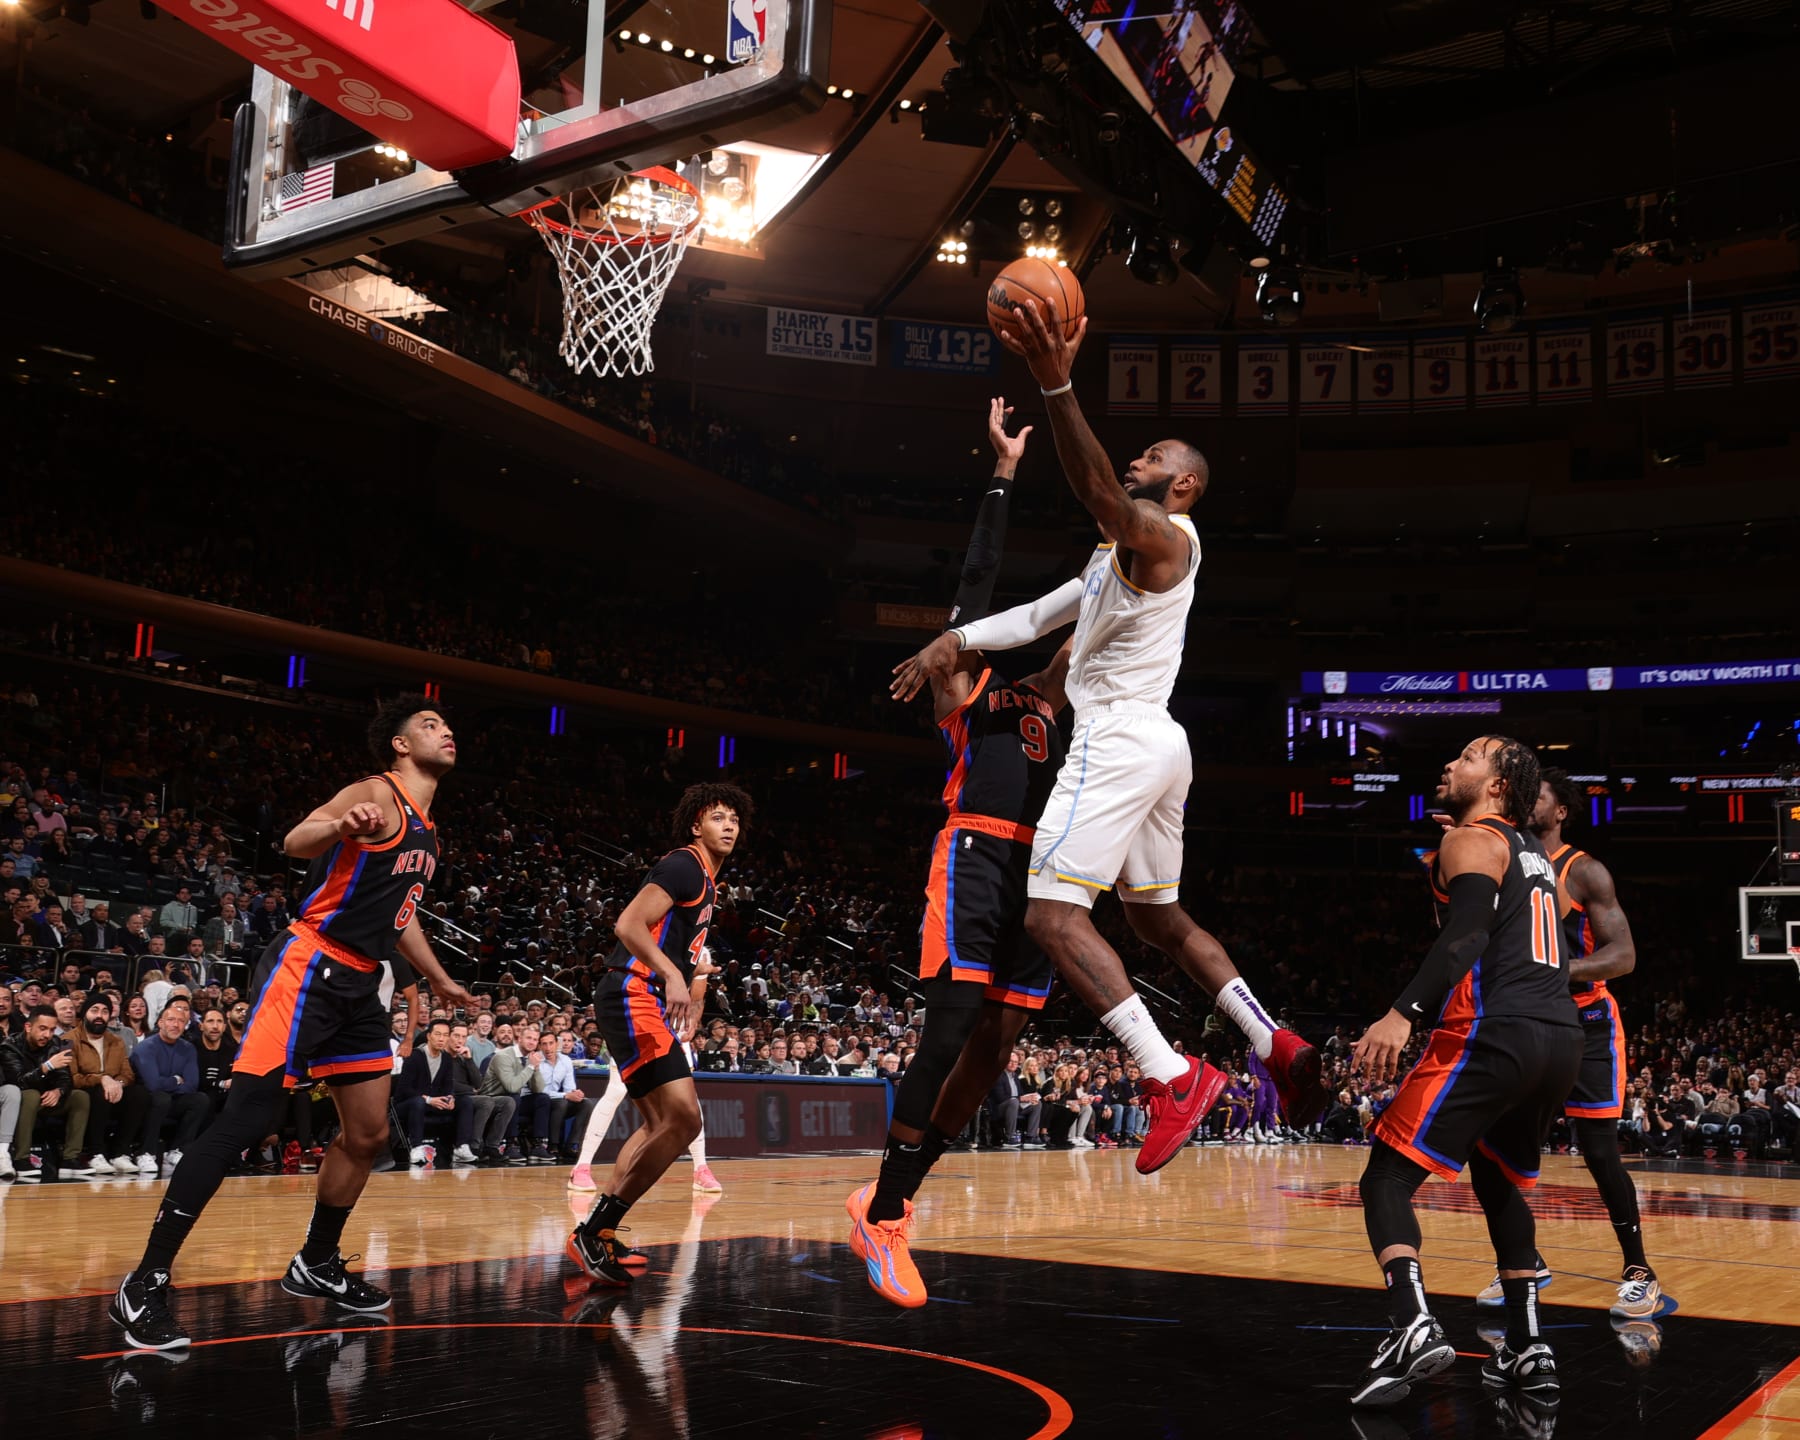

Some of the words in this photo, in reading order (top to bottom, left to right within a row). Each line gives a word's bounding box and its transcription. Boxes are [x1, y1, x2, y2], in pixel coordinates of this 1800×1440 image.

[189, 0, 343, 79] State
[732, 35, 753, 57] NBA
[308, 296, 368, 334] CHASE
[388, 331, 436, 364] BRIDGE
[772, 327, 833, 348] STYLES
[777, 311, 828, 330] HARRY
[840, 318, 873, 352] 15
[904, 326, 934, 344] BILLY
[905, 343, 932, 361] JOEL
[937, 329, 991, 365] 132
[1614, 341, 1657, 380] 19
[1679, 333, 1728, 372] 30
[1747, 324, 1799, 364] 35
[1126, 365, 1141, 399] 1
[1184, 366, 1206, 400] 2
[1253, 366, 1274, 399] 3
[1314, 364, 1337, 399] 7
[1373, 363, 1395, 397] 9
[1429, 359, 1451, 395] 9
[1485, 354, 1519, 391] 11
[1548, 351, 1581, 387] 11
[1380, 674, 1455, 692] Michelob
[1472, 672, 1549, 690] ULTRA
[1669, 668, 1712, 682] ONLY
[1712, 665, 1773, 681] WORTH
[1774, 664, 1792, 677] IT
[1019, 713, 1049, 763] 9
[1702, 779, 1729, 790] NEW
[1732, 778, 1764, 789] YORK
[394, 882, 424, 931] 6
[1530, 886, 1560, 969] 11
[688, 927, 709, 966] 4
